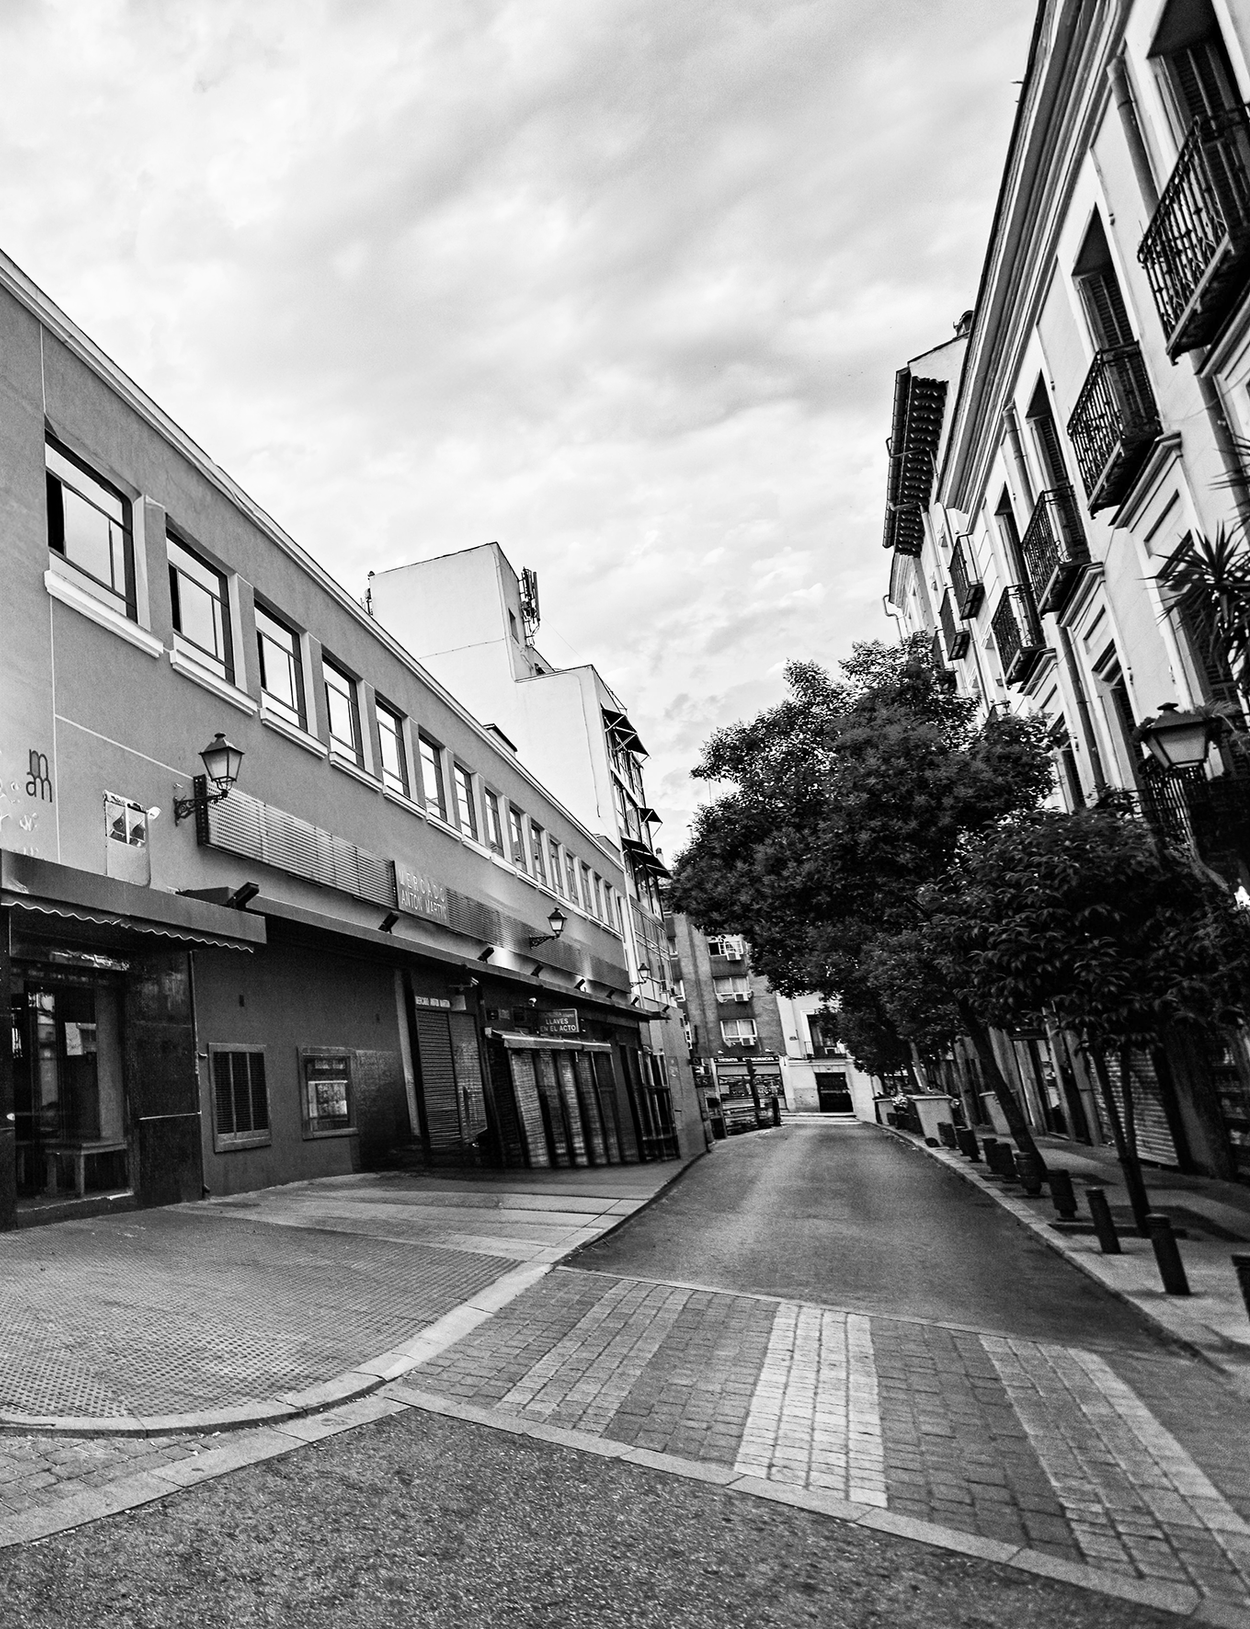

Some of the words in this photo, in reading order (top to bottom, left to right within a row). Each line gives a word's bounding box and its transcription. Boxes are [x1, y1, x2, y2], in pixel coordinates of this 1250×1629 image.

[399, 869, 445, 902] MERCADO
[539, 1025, 549, 1033] EN
[559, 1024, 577, 1032] ACTO
